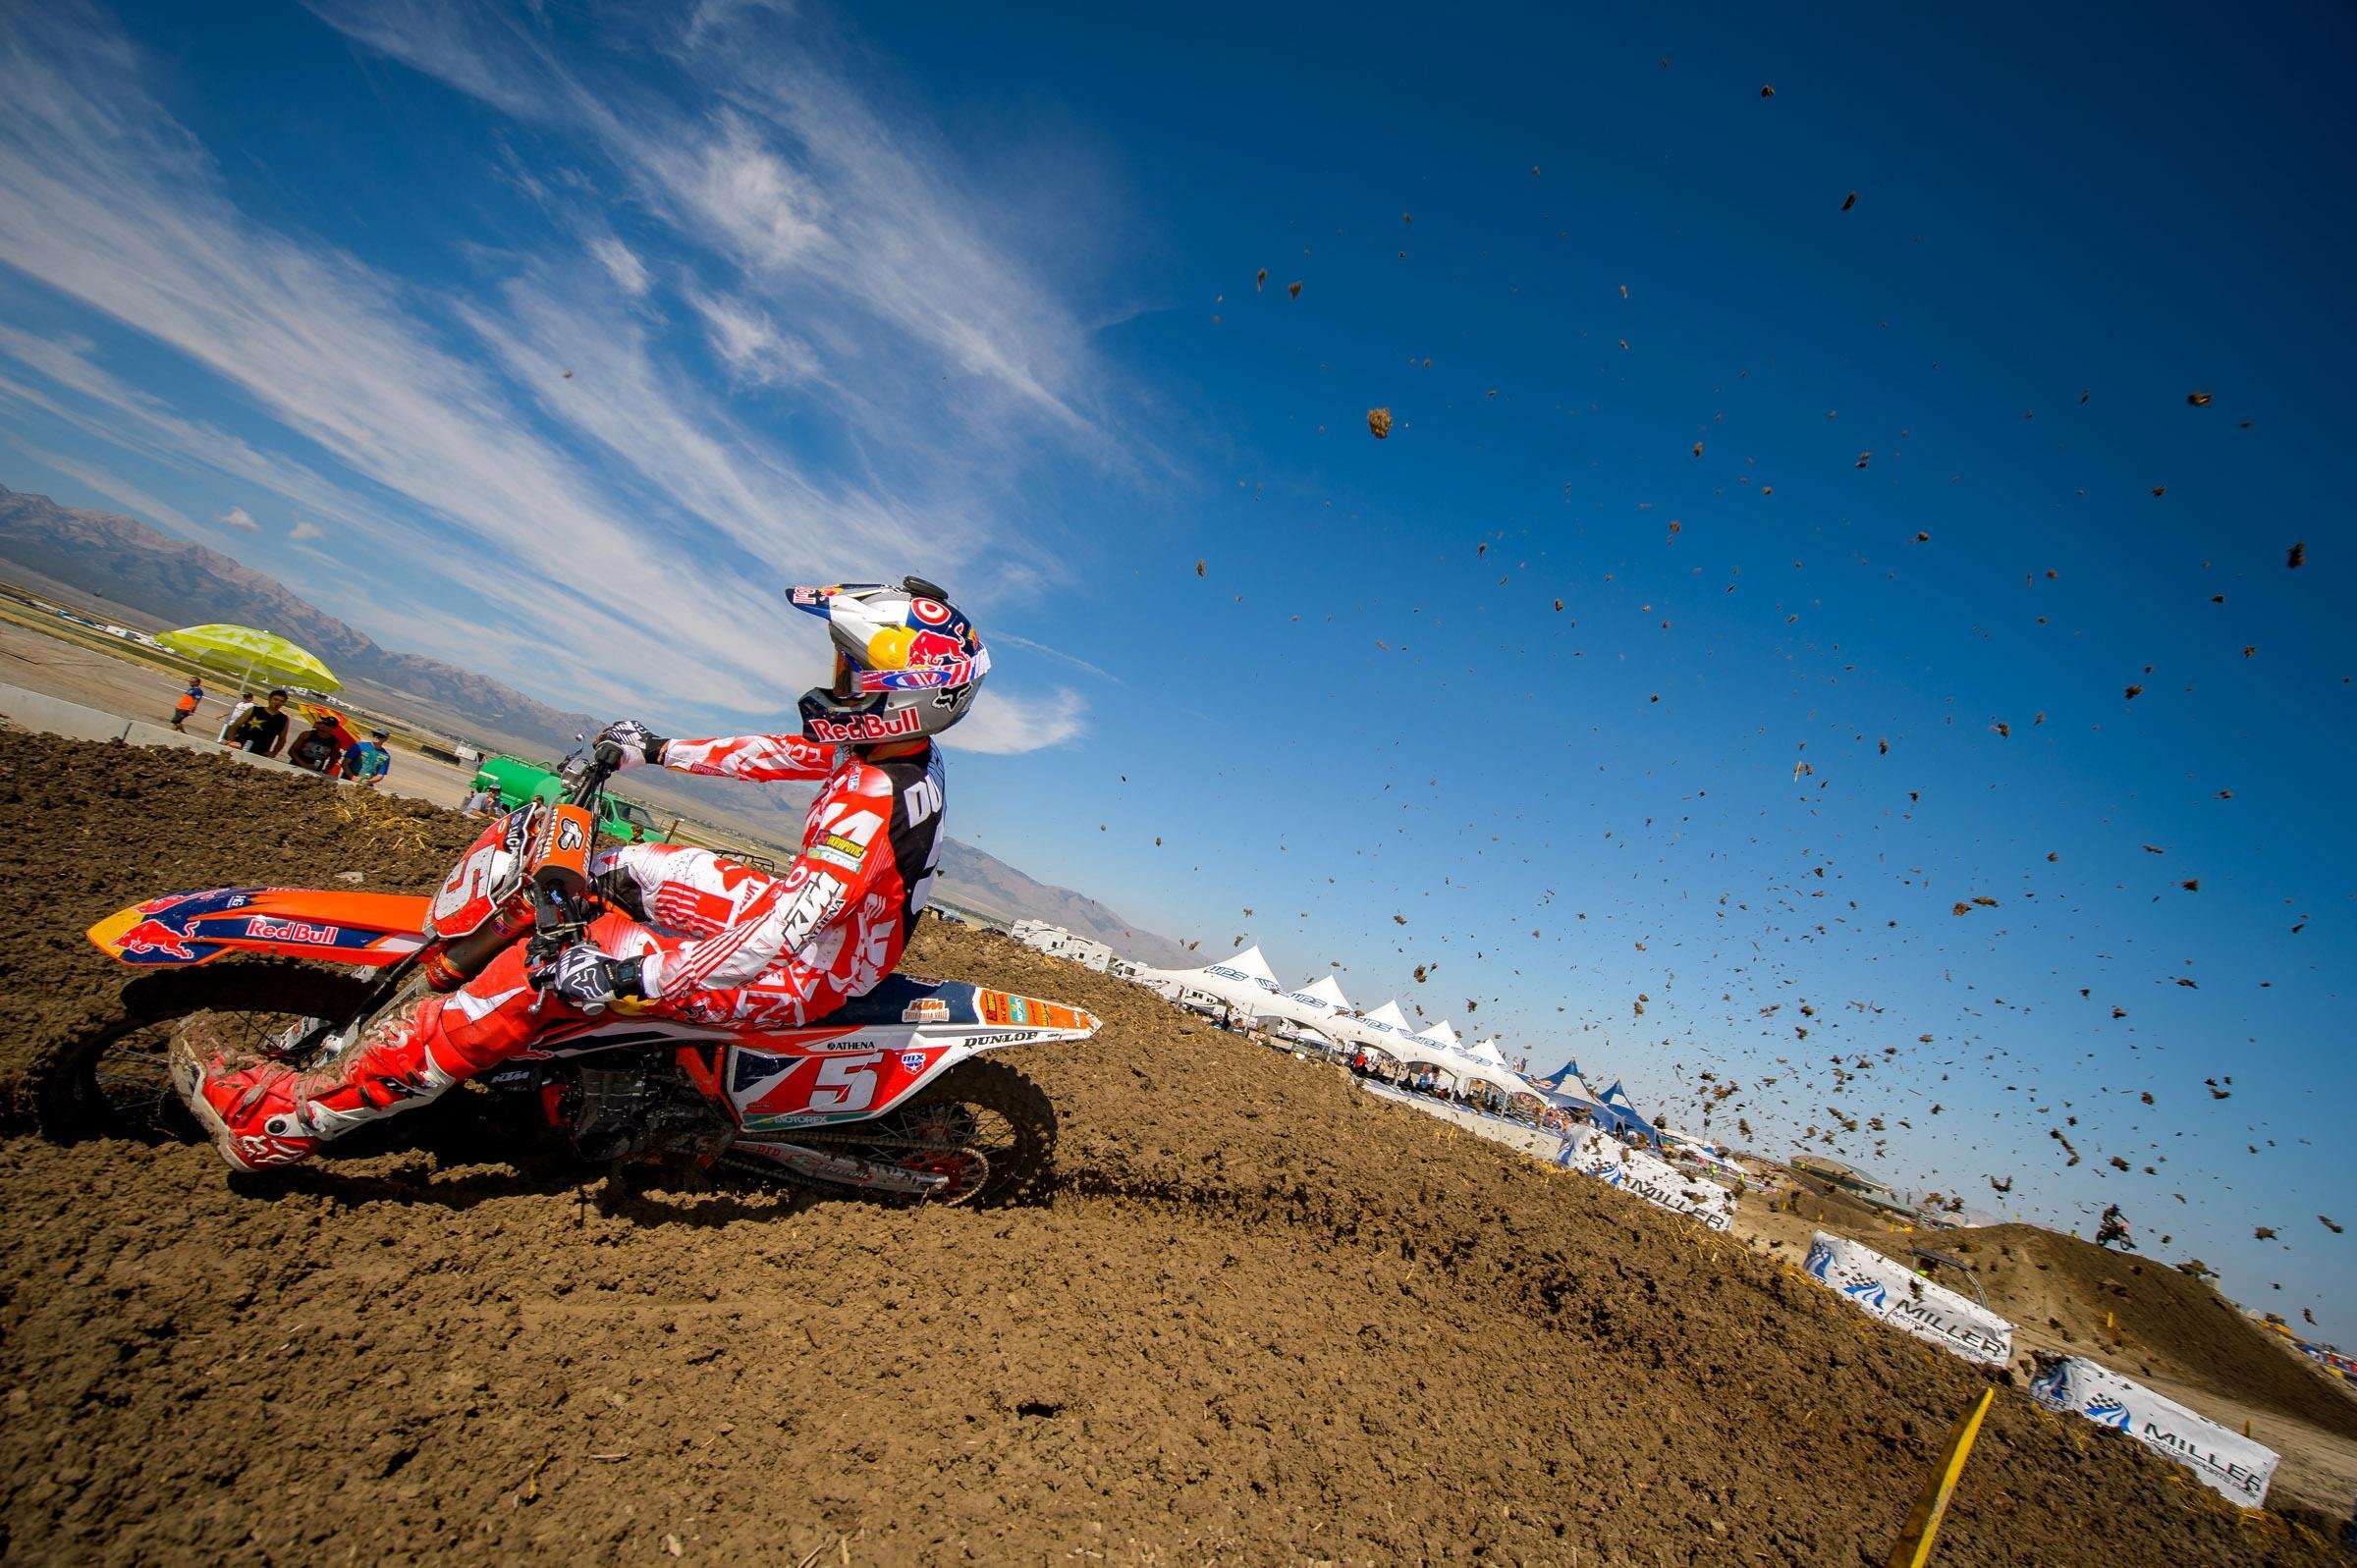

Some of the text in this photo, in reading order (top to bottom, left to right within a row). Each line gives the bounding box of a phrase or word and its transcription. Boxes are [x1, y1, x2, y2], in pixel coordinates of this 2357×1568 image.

[808, 706, 921, 742] Red Bull
[434, 844, 496, 921] 5
[246, 918, 339, 945] Red Bull
[782, 870, 842, 952] KTM
[807, 899, 845, 943] ATHENA
[910, 1000, 944, 1010] KTM
[836, 1042, 875, 1051] ATHENA
[962, 1031, 1038, 1049] DUNLOP
[808, 1052, 884, 1112] 5
[775, 1115, 829, 1125] MOTOREX
[1629, 1179, 1726, 1230] MILLER
[1894, 1298, 2002, 1359] MILLER
[2143, 1422, 2263, 1494] MILLER
